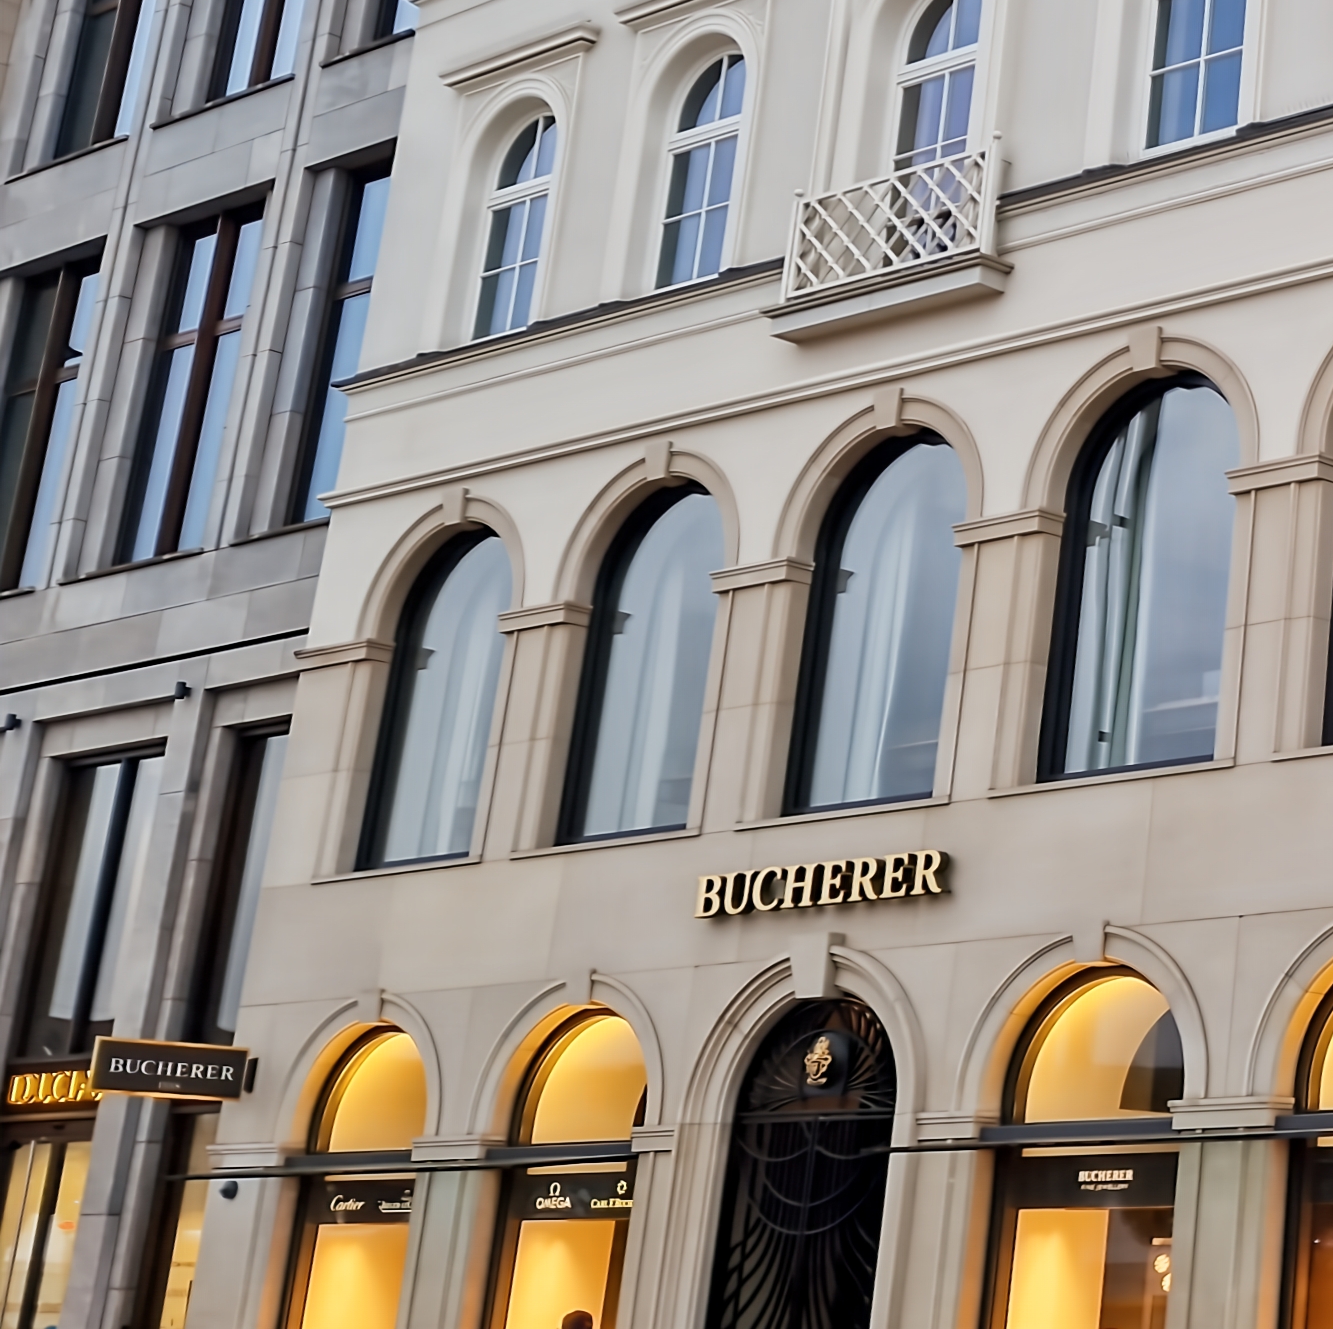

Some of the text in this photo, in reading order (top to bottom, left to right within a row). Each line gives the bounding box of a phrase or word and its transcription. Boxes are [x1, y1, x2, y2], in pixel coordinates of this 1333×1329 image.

[694, 849, 947, 919] BUCHERER
[109, 1057, 235, 1081] BUCHERER
[1078, 1169, 1134, 1182] BUCHERER
[329, 1194, 366, 1212] Cartier
[535, 1196, 572, 1210] OMEGA
